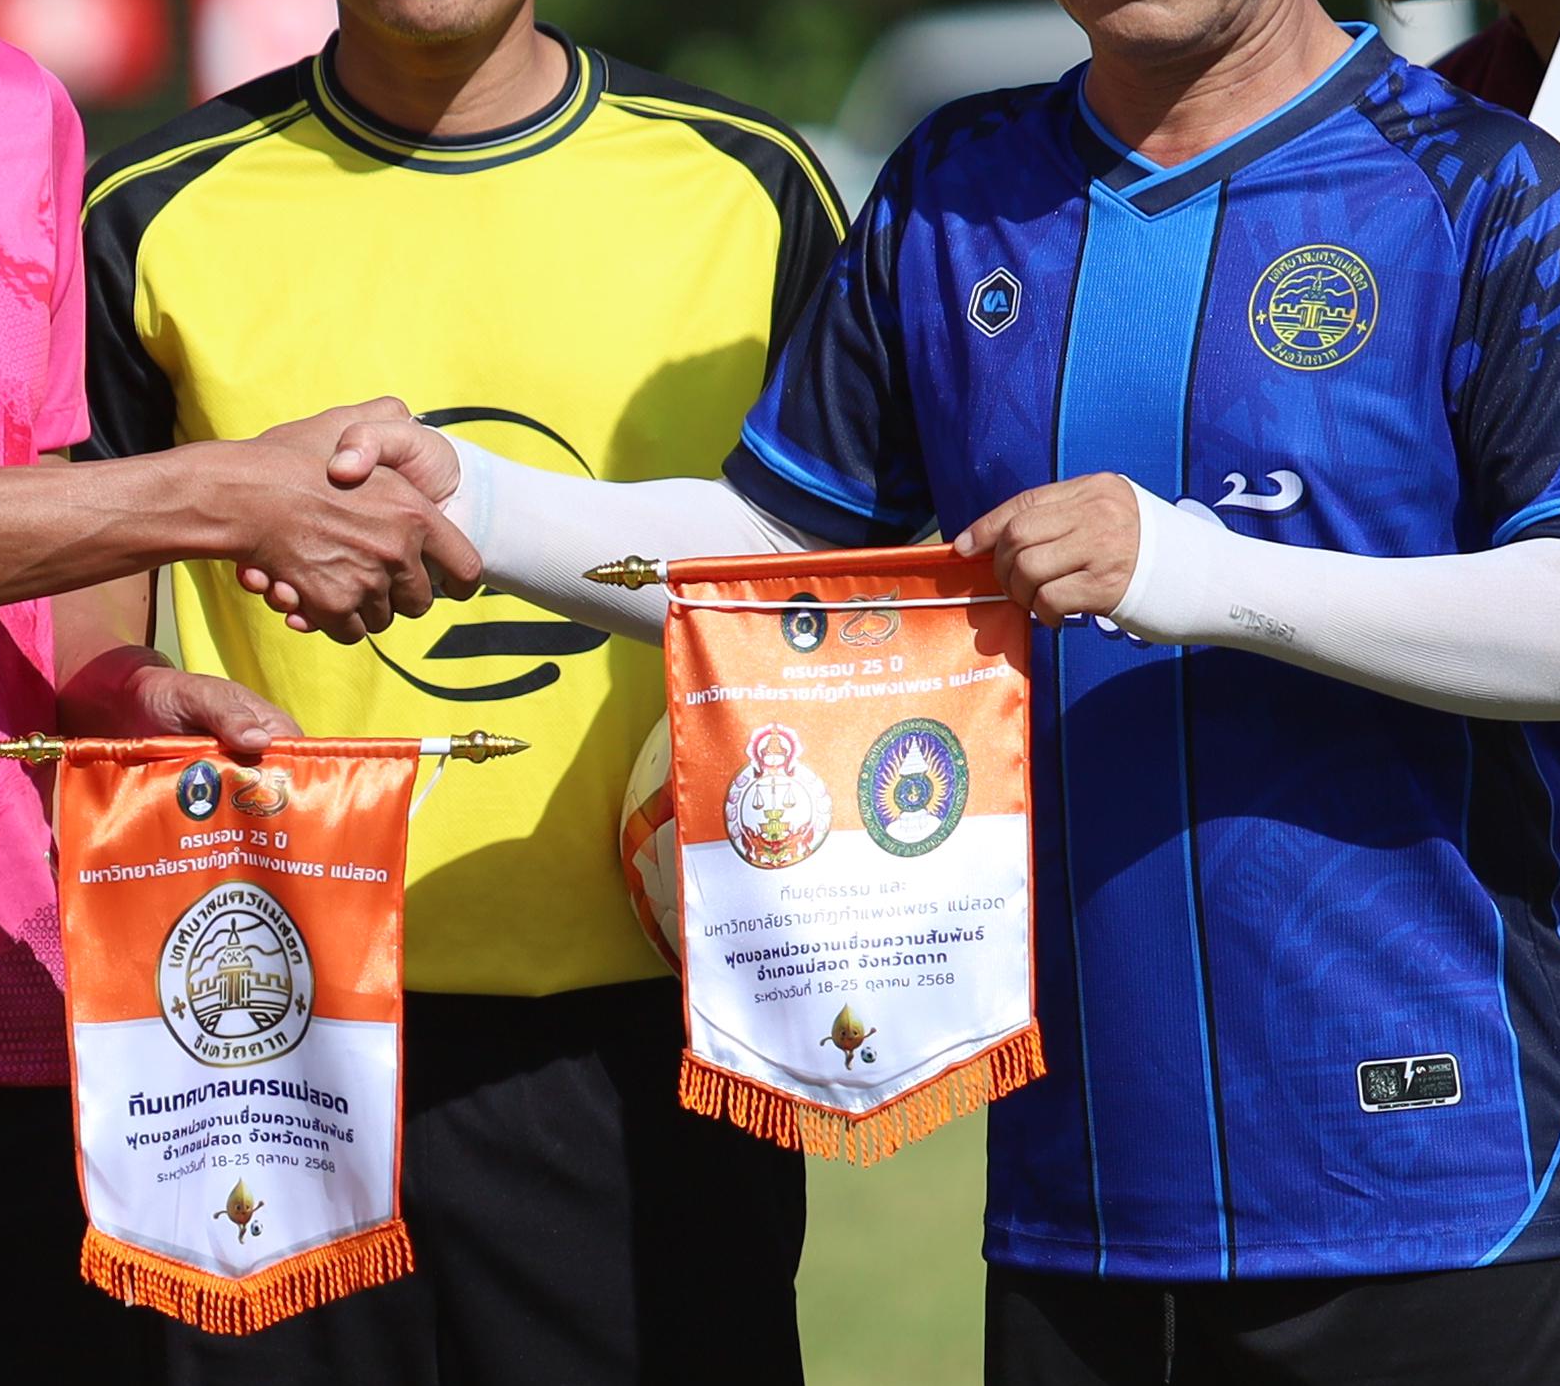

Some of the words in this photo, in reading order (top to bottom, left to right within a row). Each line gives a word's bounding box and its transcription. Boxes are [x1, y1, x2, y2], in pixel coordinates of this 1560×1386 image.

[782, 662, 855, 680] ครบรอบ
[862, 659, 881, 675] 25
[889, 655, 903, 674] ปี
[949, 664, 1010, 688] แม่สอด
[180, 828, 243, 850] ครบรอบ
[250, 830, 267, 846] 25
[274, 831, 288, 849] ปี
[330, 865, 388, 882] แม่สอด
[780, 883, 870, 903] ทีมยุติธรรม
[879, 881, 907, 894] และ
[947, 895, 1006, 913] แม่สอด
[168, 891, 303, 968] เทศบาลนครแม่สอด
[724, 925, 985, 967] ฟุตบอลหน่วยงานเชื่อมความสัมพันธ์
[757, 958, 849, 981] อำเภอแม่สอด
[858, 951, 948, 970] จังหวัดตาก
[818, 979, 858, 994] 18-25
[865, 976, 910, 992] ตุลาคม
[917, 972, 955, 986] 2568
[128, 1078, 349, 1116] ทีมเทศบาลนครแม่สอด
[249, 1128, 330, 1153] จังหวัดตาก
[211, 1154, 250, 1168] 18-25
[256, 1154, 299, 1168] ตุลาคม
[305, 1156, 336, 1173] 2568
